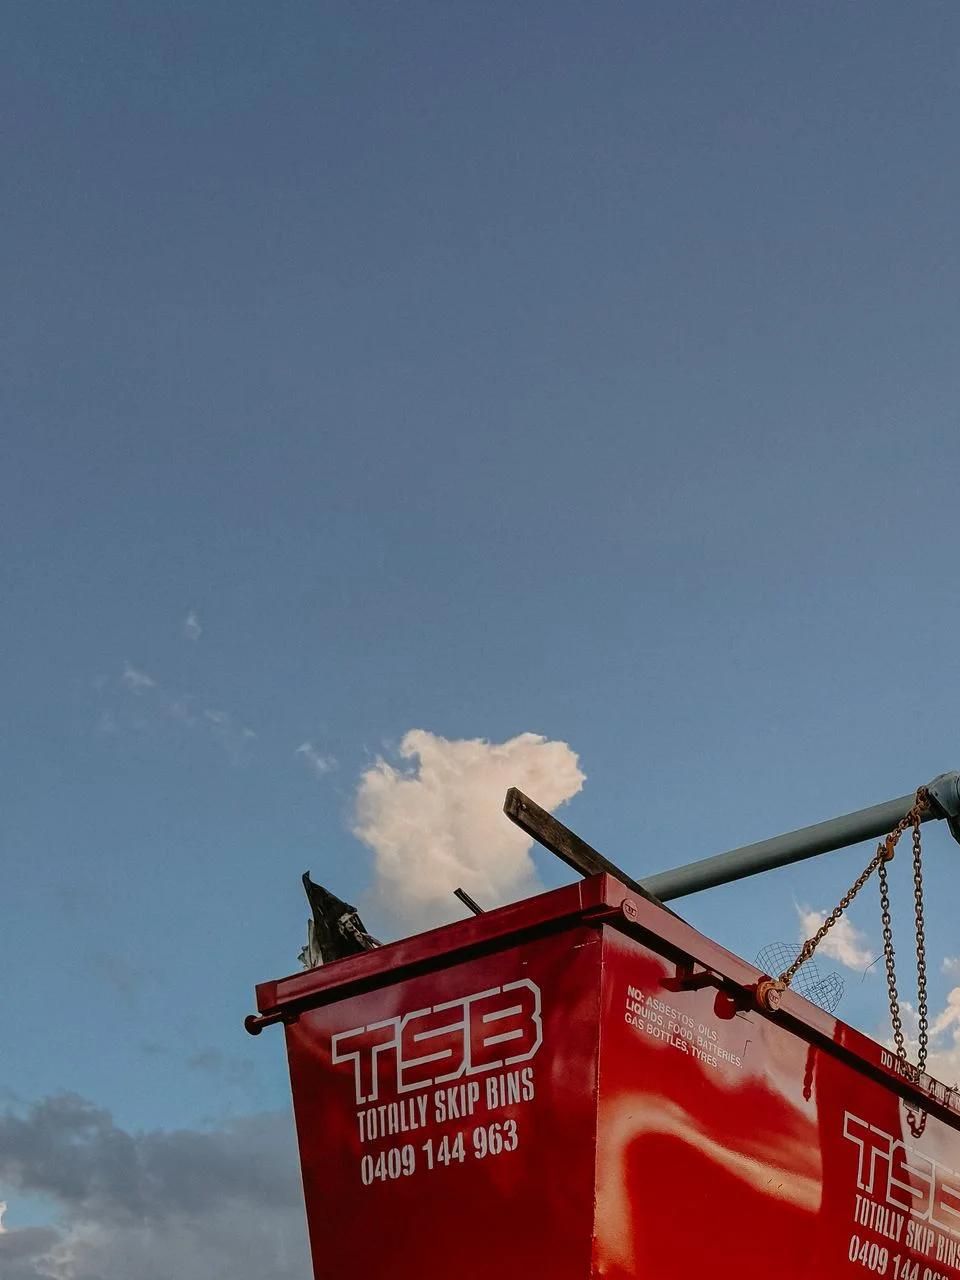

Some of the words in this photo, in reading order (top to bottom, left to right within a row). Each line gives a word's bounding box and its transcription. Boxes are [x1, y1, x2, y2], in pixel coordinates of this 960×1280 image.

[331, 978, 543, 1105] TSB
[624, 1012, 644, 1030] GAS
[646, 1025, 689, 1055] BOTTLES,
[880, 1050, 893, 1069] DO
[357, 1094, 428, 1142] TOTALLY
[434, 1082, 480, 1123] SKIP
[486, 1067, 535, 1111] BINS
[361, 1144, 416, 1186] 0409
[422, 1132, 466, 1170] 144
[473, 1119, 519, 1159] 963
[848, 1234, 889, 1276] 0409
[854, 1193, 905, 1243] TOTALLY
[905, 1218, 935, 1257] SKIP
